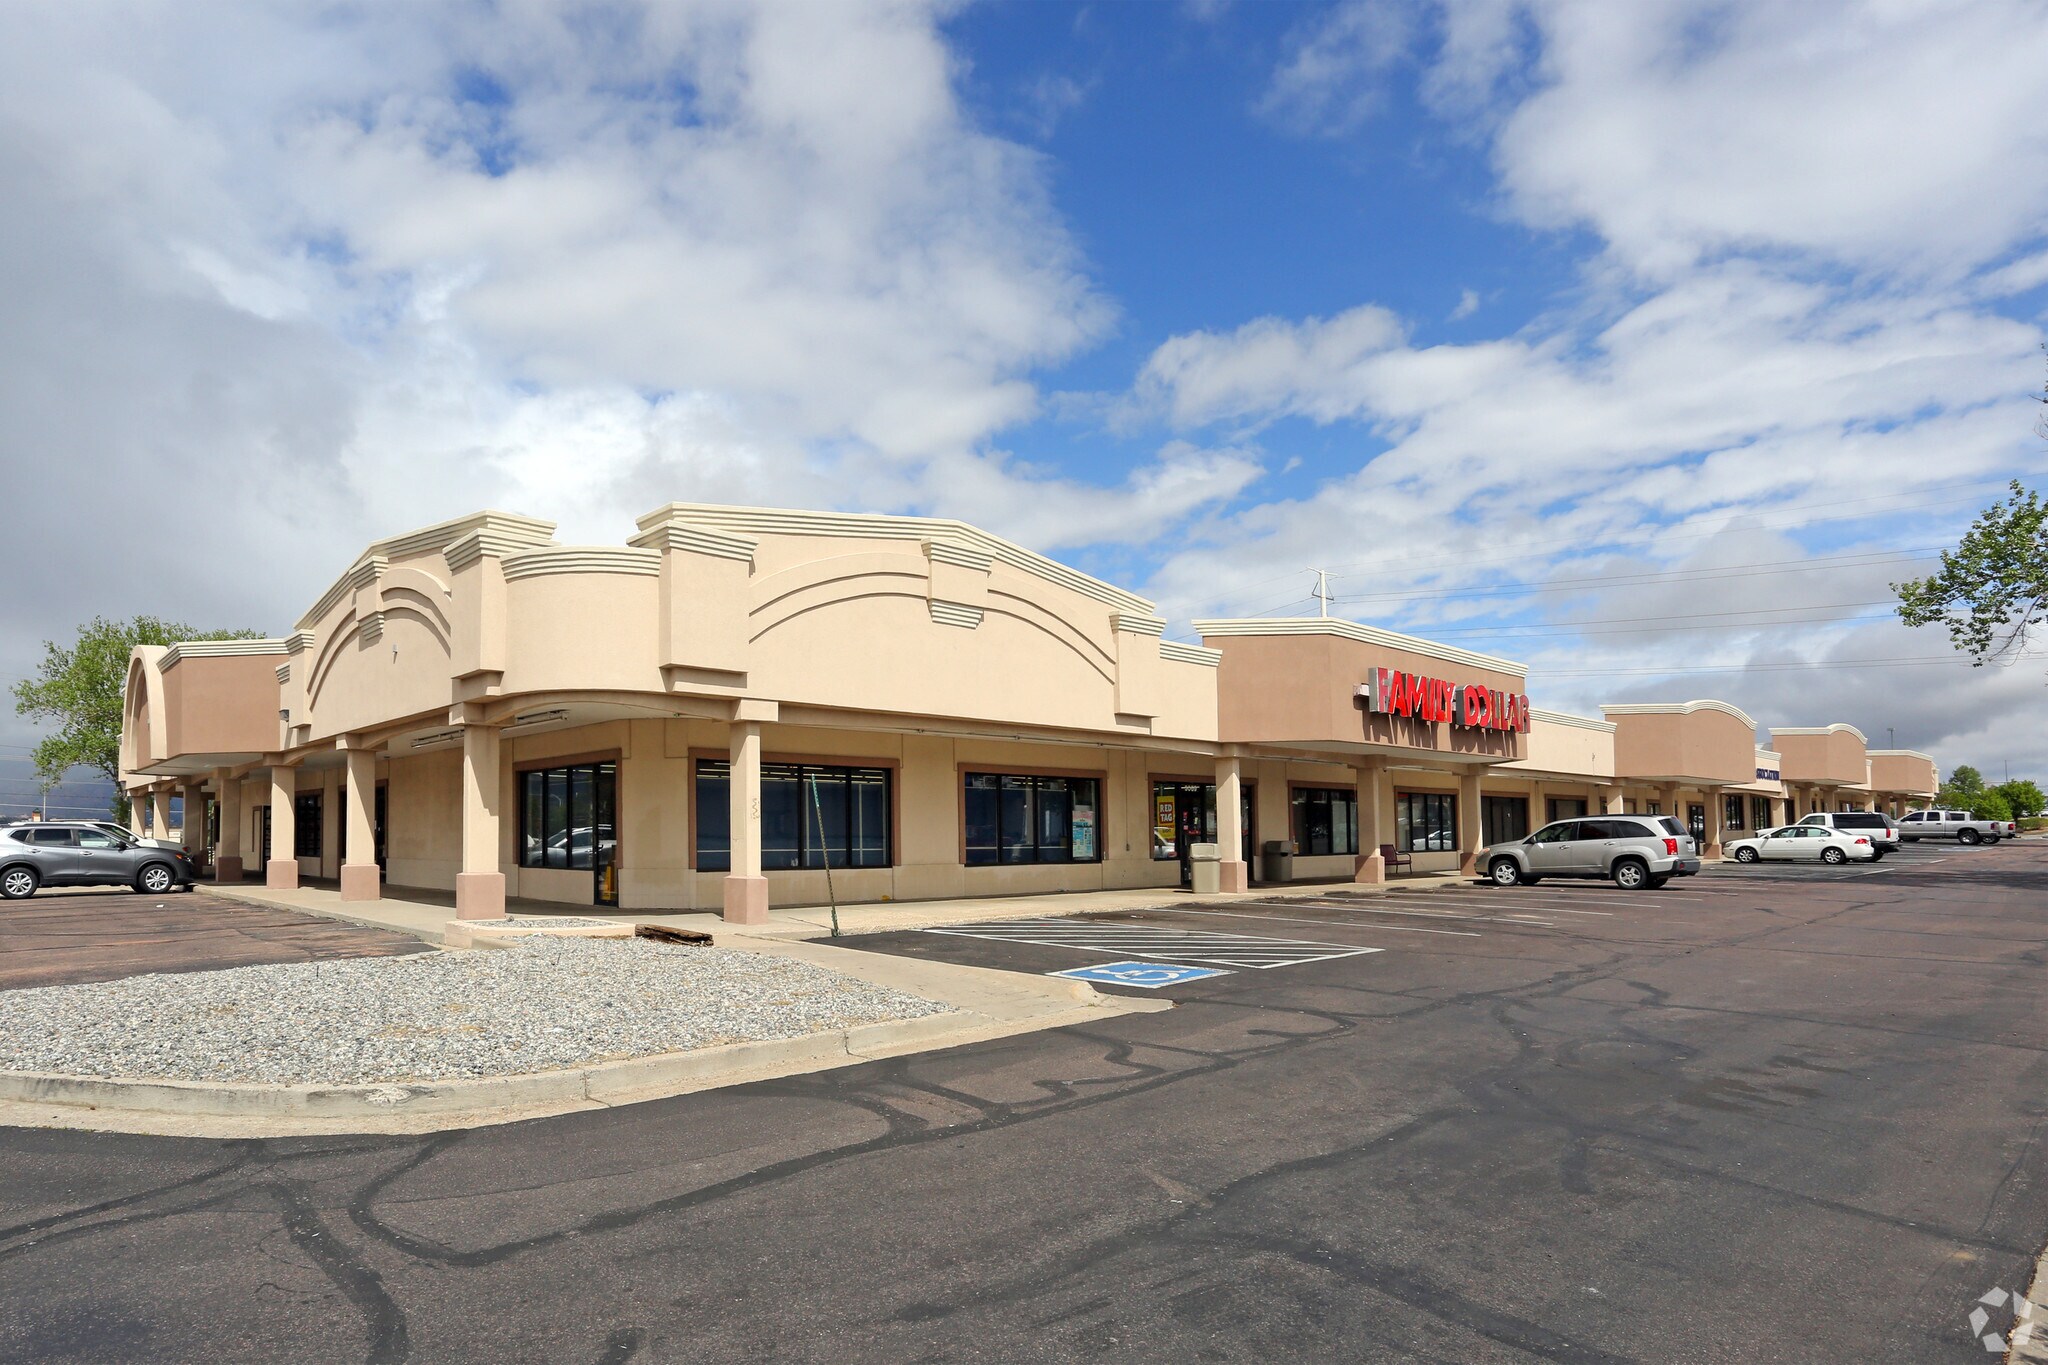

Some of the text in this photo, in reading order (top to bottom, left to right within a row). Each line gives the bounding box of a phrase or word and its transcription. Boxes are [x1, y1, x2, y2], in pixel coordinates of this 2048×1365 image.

[1368, 667, 1531, 734] FAMILY DOLLAR
[1159, 803, 1172, 813] RED
[1160, 813, 1173, 822] TAG
